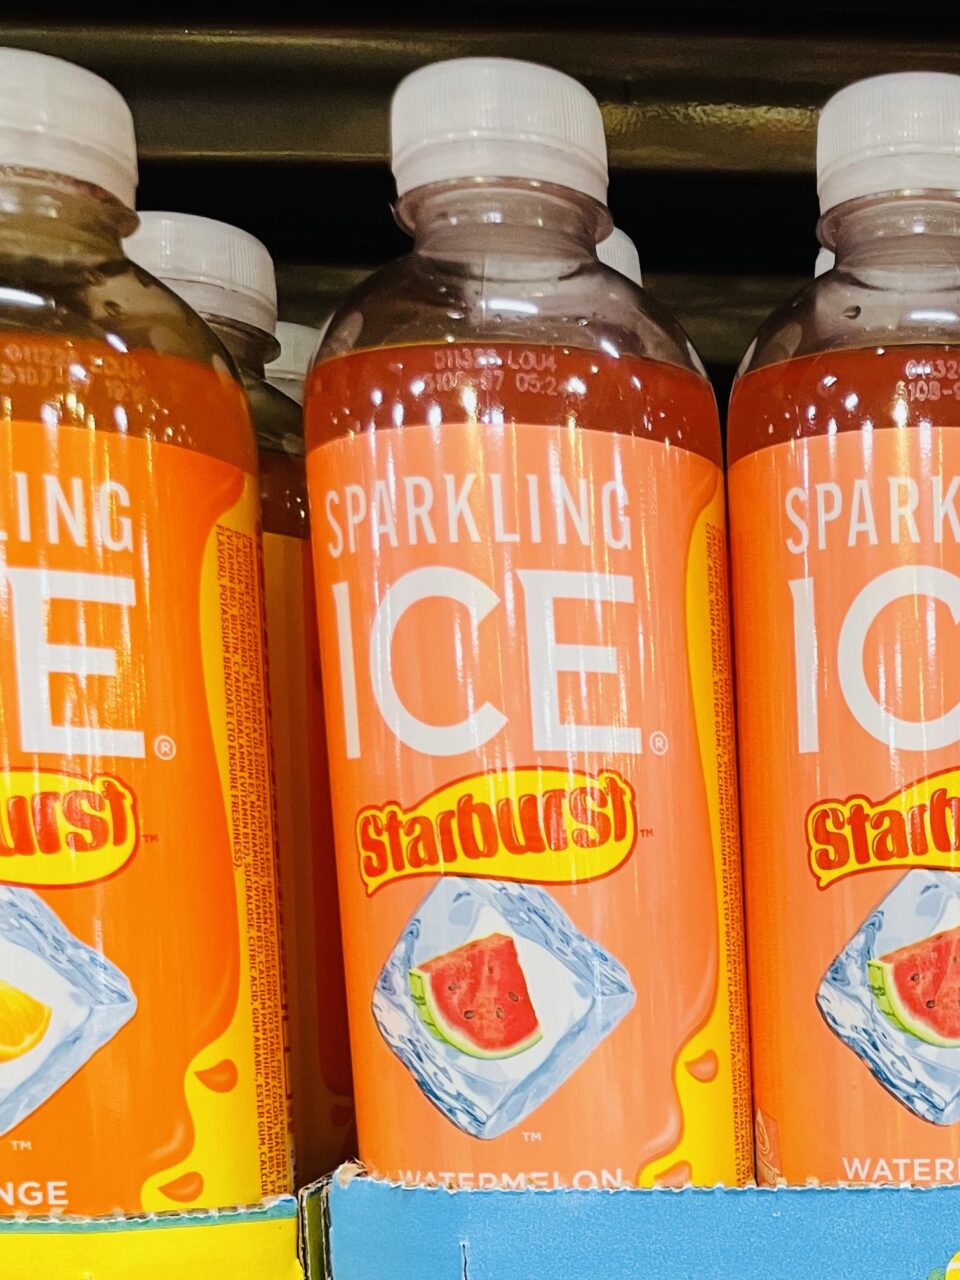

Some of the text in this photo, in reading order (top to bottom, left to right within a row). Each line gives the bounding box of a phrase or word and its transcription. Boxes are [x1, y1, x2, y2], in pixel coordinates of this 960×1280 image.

[327, 474, 632, 558] SPARKLING
[217, 524, 242, 871] FLAVOR), POTASSIUM BENZOATE (TO ENSURE FRESHNESS).
[332, 566, 643, 759] ICE
[361, 771, 633, 879] Starburst
